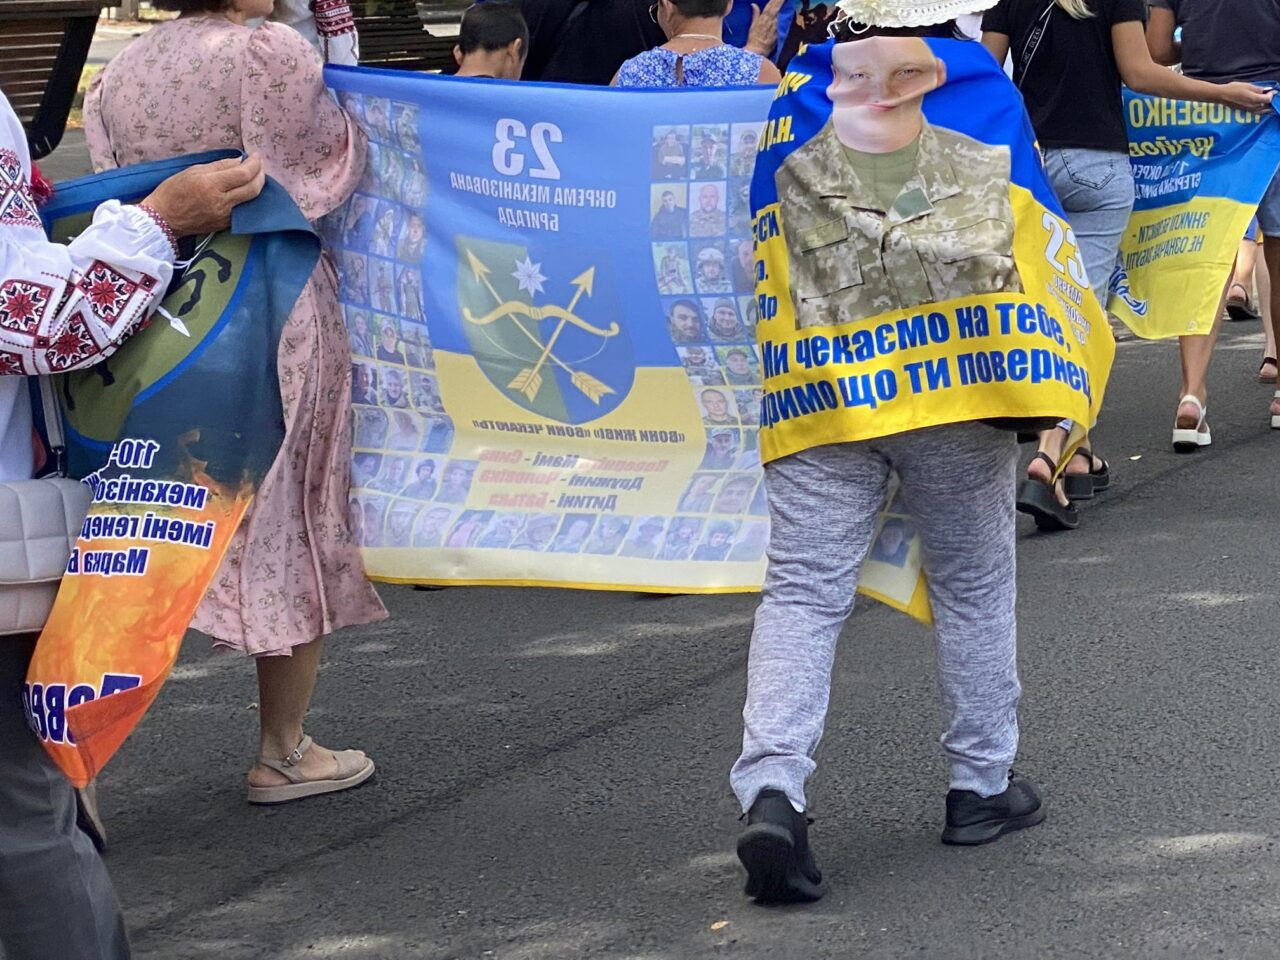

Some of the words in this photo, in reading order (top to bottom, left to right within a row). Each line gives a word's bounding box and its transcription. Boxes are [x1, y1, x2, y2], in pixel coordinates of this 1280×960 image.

[795, 311, 949, 368] чекаємо
[955, 305, 989, 340] на
[995, 302, 1071, 353] тебе,
[760, 380, 837, 429] іримо
[837, 368, 898, 409] що
[904, 356, 951, 394] ти
